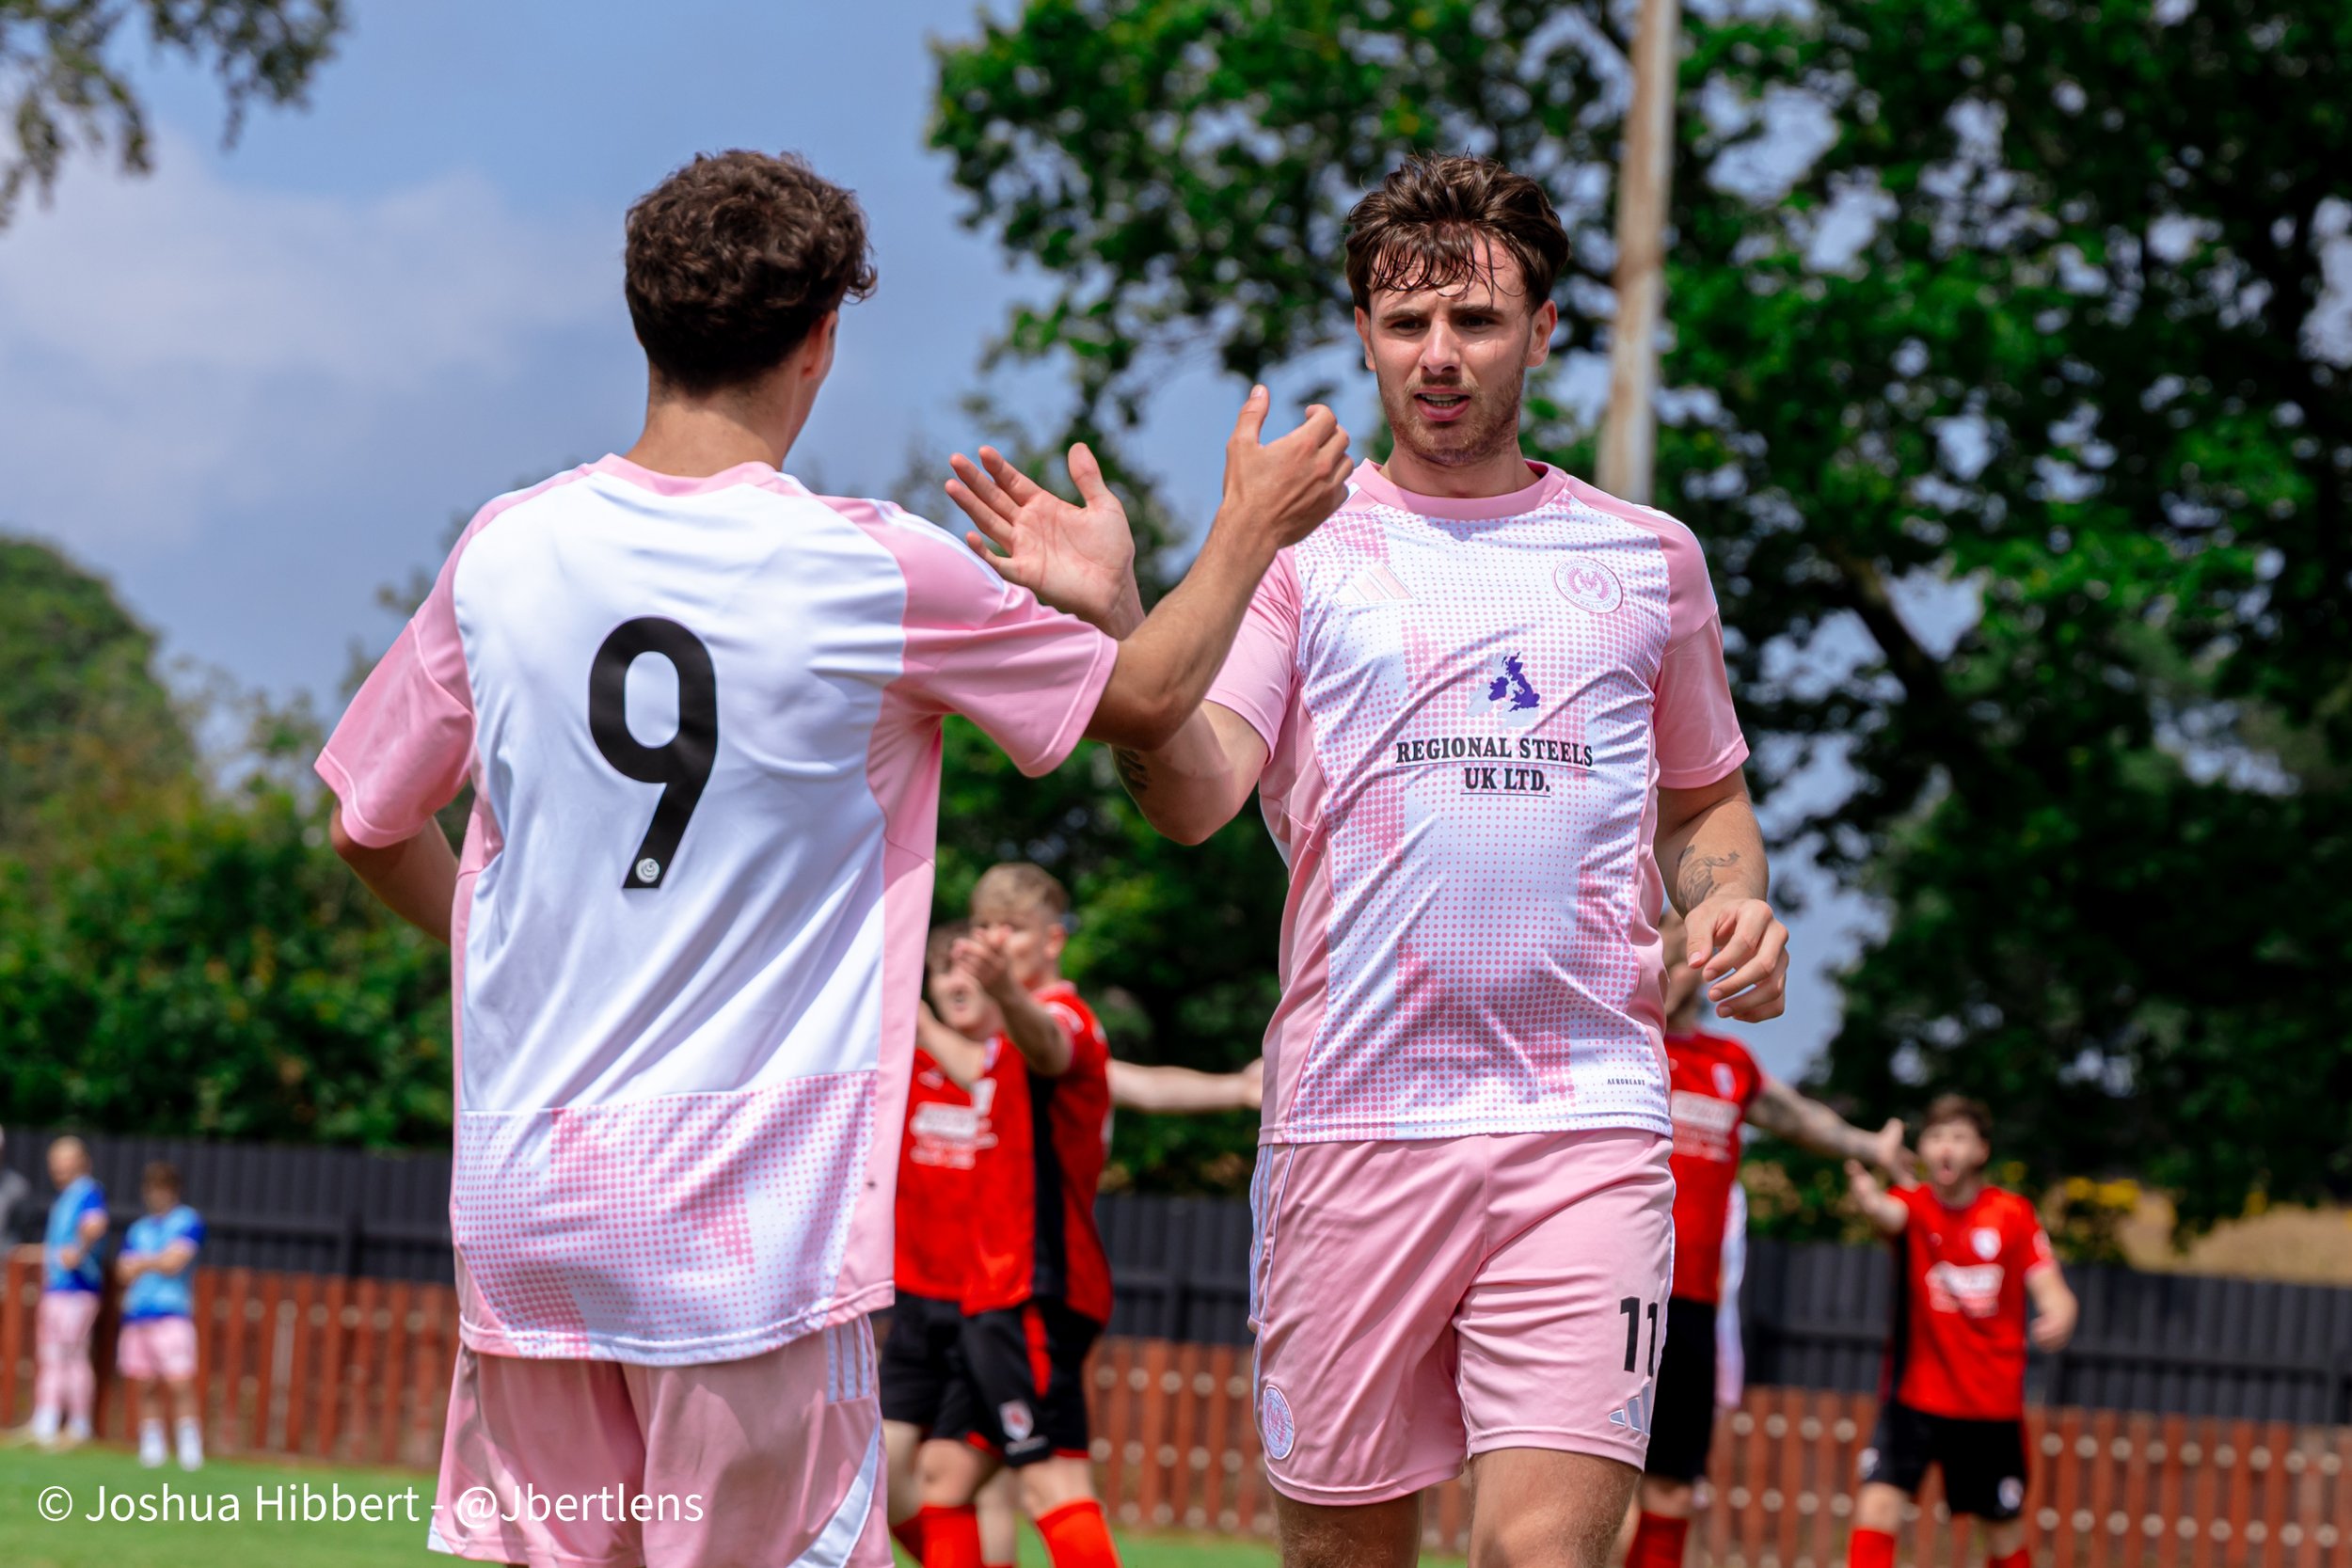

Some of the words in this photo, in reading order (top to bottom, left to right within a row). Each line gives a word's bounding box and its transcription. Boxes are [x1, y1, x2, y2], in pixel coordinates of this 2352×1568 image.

[589, 618, 718, 889] 9
[1395, 737, 1514, 763] REGIONAL
[1518, 737, 1594, 768] STEELS
[1464, 768, 1497, 790] UK
[1503, 768, 1551, 792] LTD.
[1607, 1078, 1645, 1086] AEROREADY
[1619, 1295, 1659, 1378] 11
